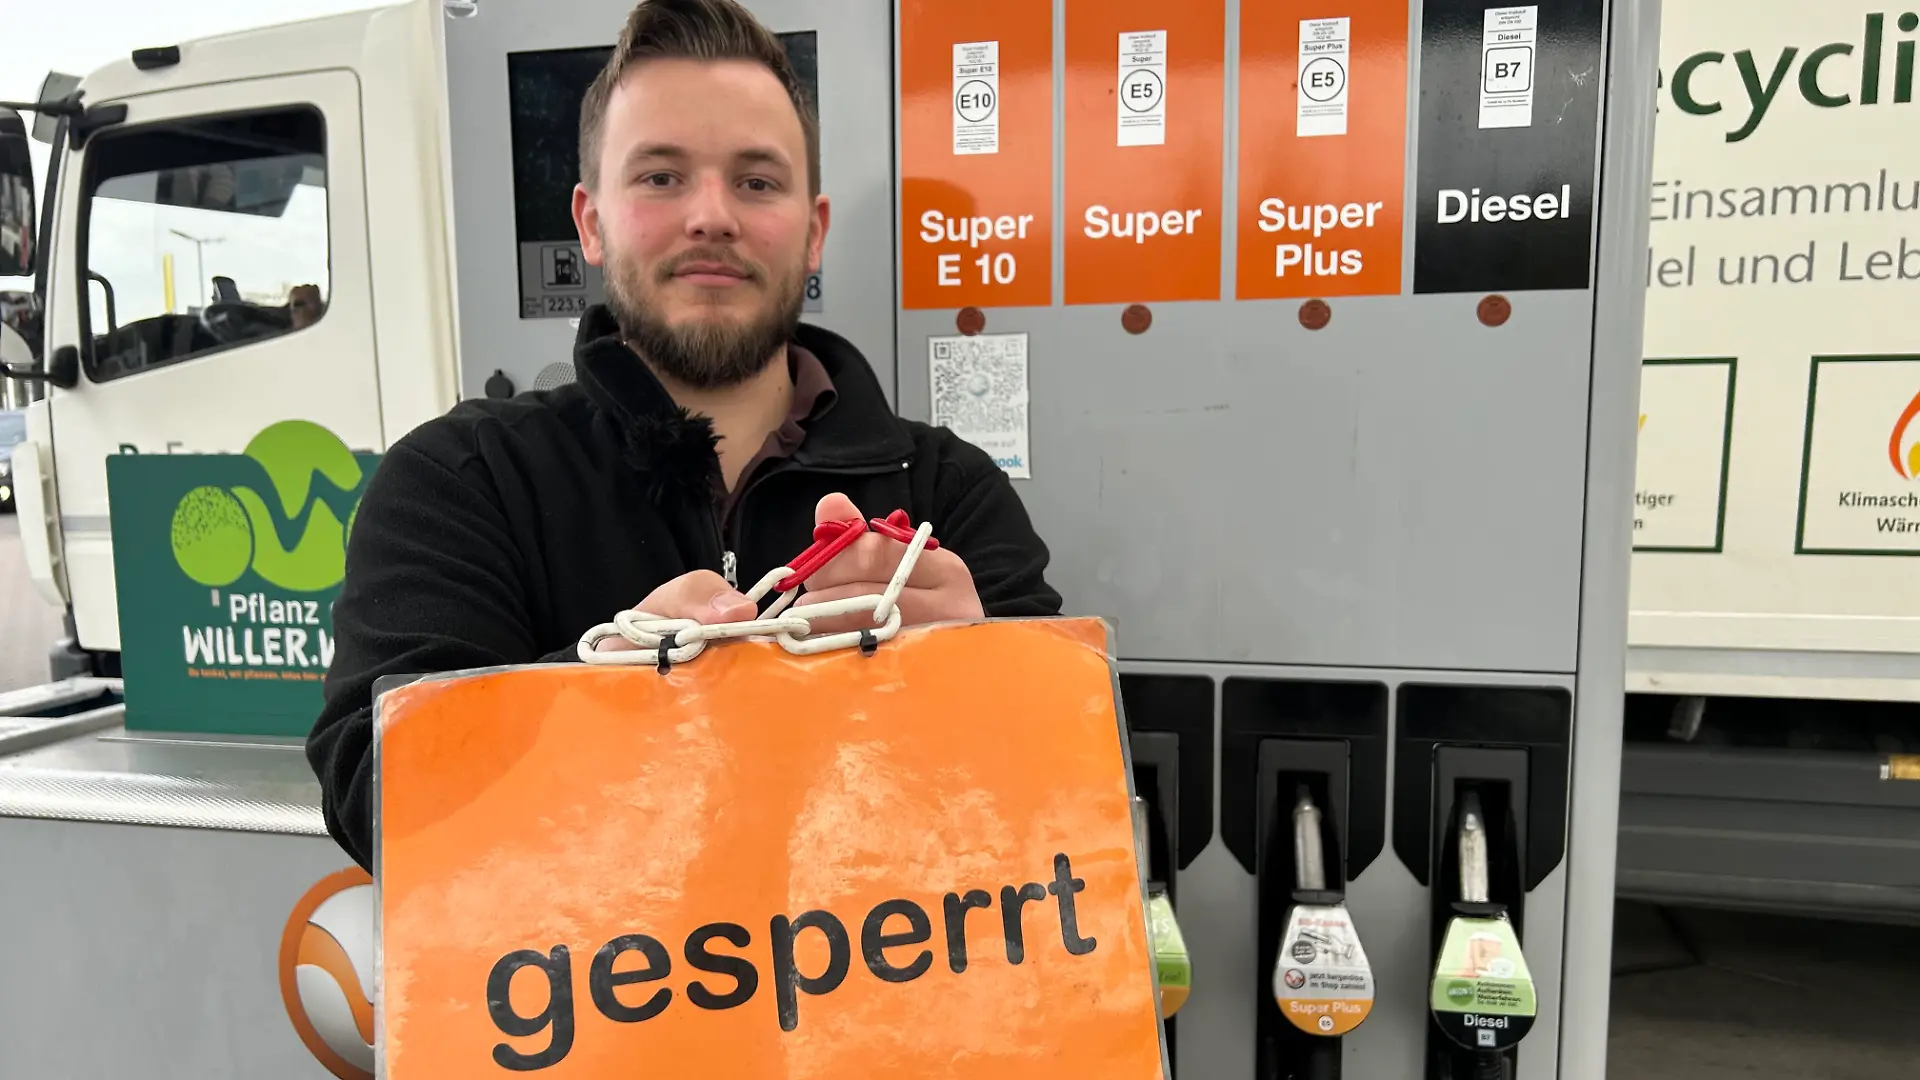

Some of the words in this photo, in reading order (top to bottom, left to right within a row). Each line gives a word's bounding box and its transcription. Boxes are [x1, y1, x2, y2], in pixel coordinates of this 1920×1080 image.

[1304, 44, 1326, 52] Super
[1497, 32, 1521, 41] Diesel
[1131, 55, 1152, 63] Super
[1494, 62, 1522, 79] B7
[1311, 72, 1335, 88] E5
[1655, 12, 1920, 143] cycli
[960, 93, 991, 109] E10
[1131, 83, 1153, 99] E5
[1437, 184, 1570, 224] Diesel
[920, 209, 1034, 248] Super
[1083, 204, 1202, 244] Super
[1258, 197, 1383, 238] Super
[937, 254, 962, 286] E
[975, 252, 1016, 285] 10
[1275, 244, 1363, 278] Plus
[1718, 241, 1815, 284] und
[807, 276, 821, 300] 8
[1839, 491, 1920, 509] Klimasch
[229, 592, 319, 625] Pflanz
[486, 852, 1097, 1073] gesperrt
[1290, 1000, 1329, 1016] Super
[1332, 1000, 1361, 1013] Plus
[1463, 1013, 1508, 1029] Diesel
